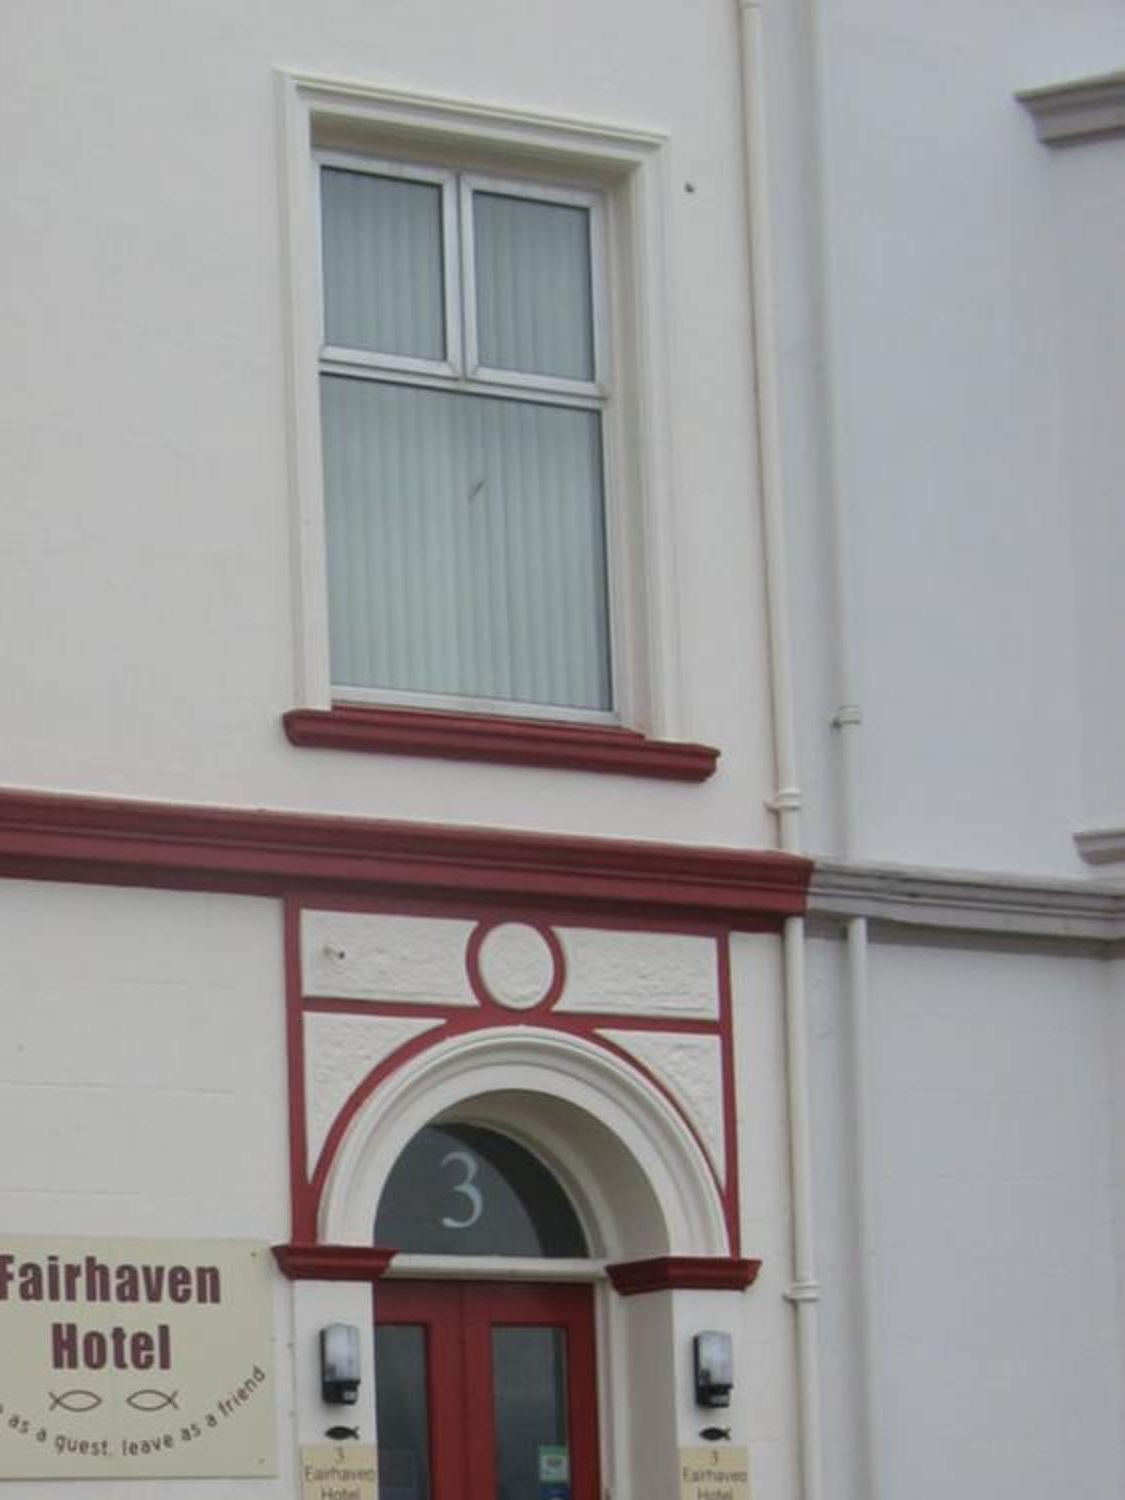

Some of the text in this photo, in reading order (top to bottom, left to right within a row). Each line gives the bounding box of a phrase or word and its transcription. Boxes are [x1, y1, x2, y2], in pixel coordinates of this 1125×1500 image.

[441, 1151, 483, 1229] 3
[51, 1323, 172, 1371] Hotel
[8, 1414, 30, 1434] as
[36, 1427, 47, 1443] a
[122, 1434, 174, 1456] leave
[180, 1423, 202, 1442] as
[205, 1413, 218, 1427] a
[218, 1365, 266, 1417] friend
